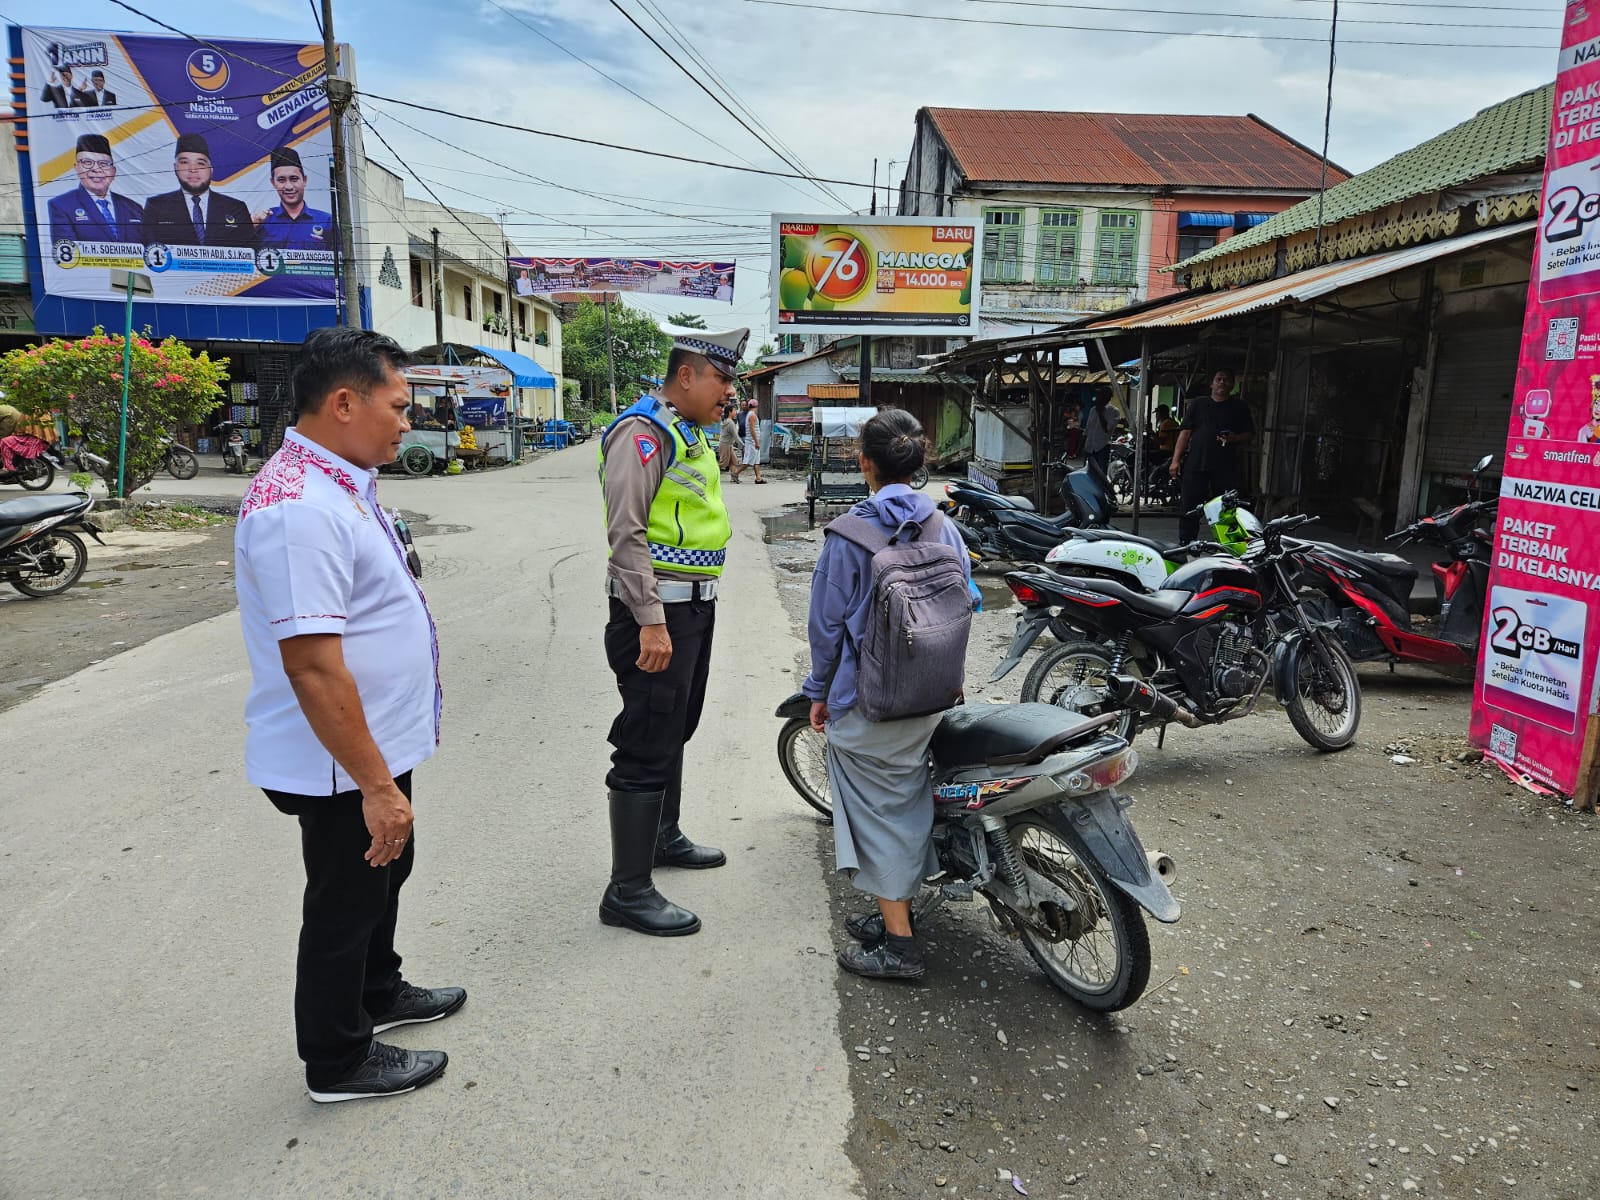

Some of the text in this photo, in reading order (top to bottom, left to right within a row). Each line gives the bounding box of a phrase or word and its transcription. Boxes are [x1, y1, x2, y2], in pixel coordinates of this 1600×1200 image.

[1574, 41, 1600, 65] NA
[202, 54, 216, 72] 5
[190, 103, 233, 113] NasDem
[1555, 128, 1575, 149] DI
[936, 228, 972, 239] BARU
[60, 246, 72, 262] 8
[91, 245, 99, 254] H.
[100, 244, 142, 255] SOEKIRMAN
[153, 249, 163, 265] 1
[177, 248, 198, 257] DIMAS
[1556, 244, 1586, 257] Bebas
[266, 253, 275, 269] 1
[816, 239, 859, 291] 76
[878, 251, 967, 270] MANGGA
[1547, 255, 1581, 270] Setelah
[905, 272, 947, 286] 14.000
[1543, 450, 1591, 464] smartfren
[1514, 482, 1566, 504] NAZWA
[1503, 516, 1556, 541] PAKET
[1500, 534, 1569, 564] TERBAIK
[1498, 551, 1514, 569] DI
[1500, 661, 1523, 675] Bebas
[1524, 668, 1567, 688] Internetan
[1491, 669, 1570, 700] Setelah Kuota Habis
